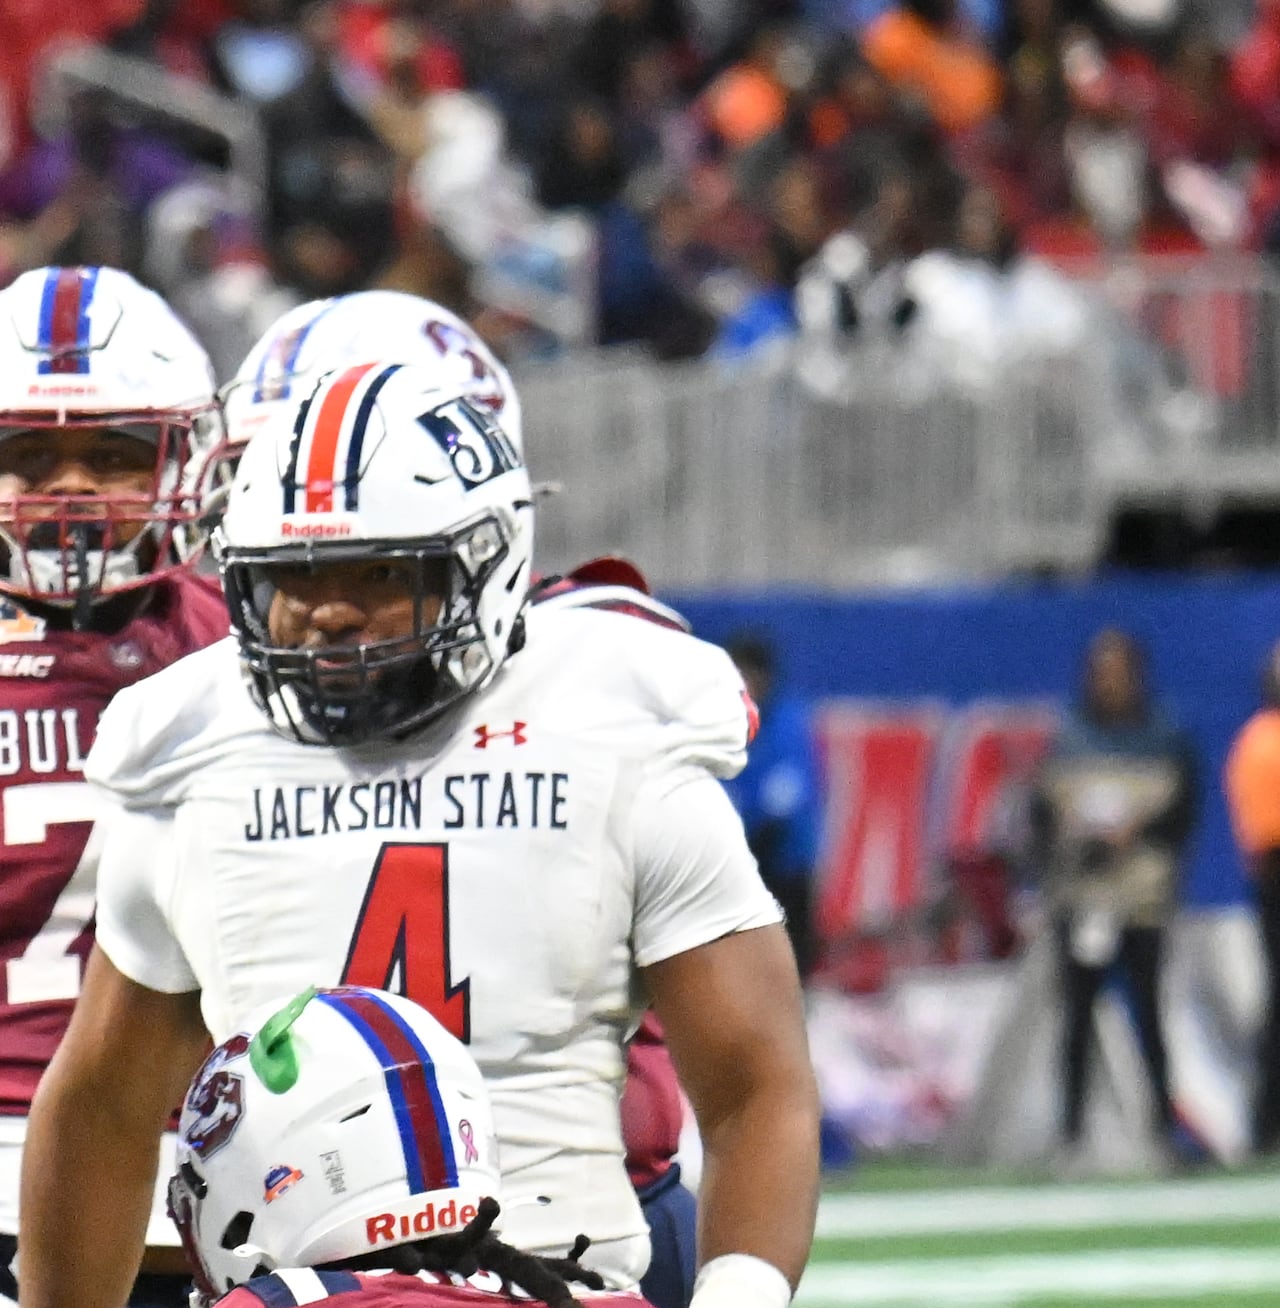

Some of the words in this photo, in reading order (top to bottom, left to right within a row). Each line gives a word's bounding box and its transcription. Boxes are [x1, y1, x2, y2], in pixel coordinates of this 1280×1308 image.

[281, 521, 351, 537] Riddell
[244, 778, 423, 842] JACKSON
[443, 771, 569, 830] STATE
[341, 841, 471, 1045] 4
[366, 1197, 482, 1245] Ridde
